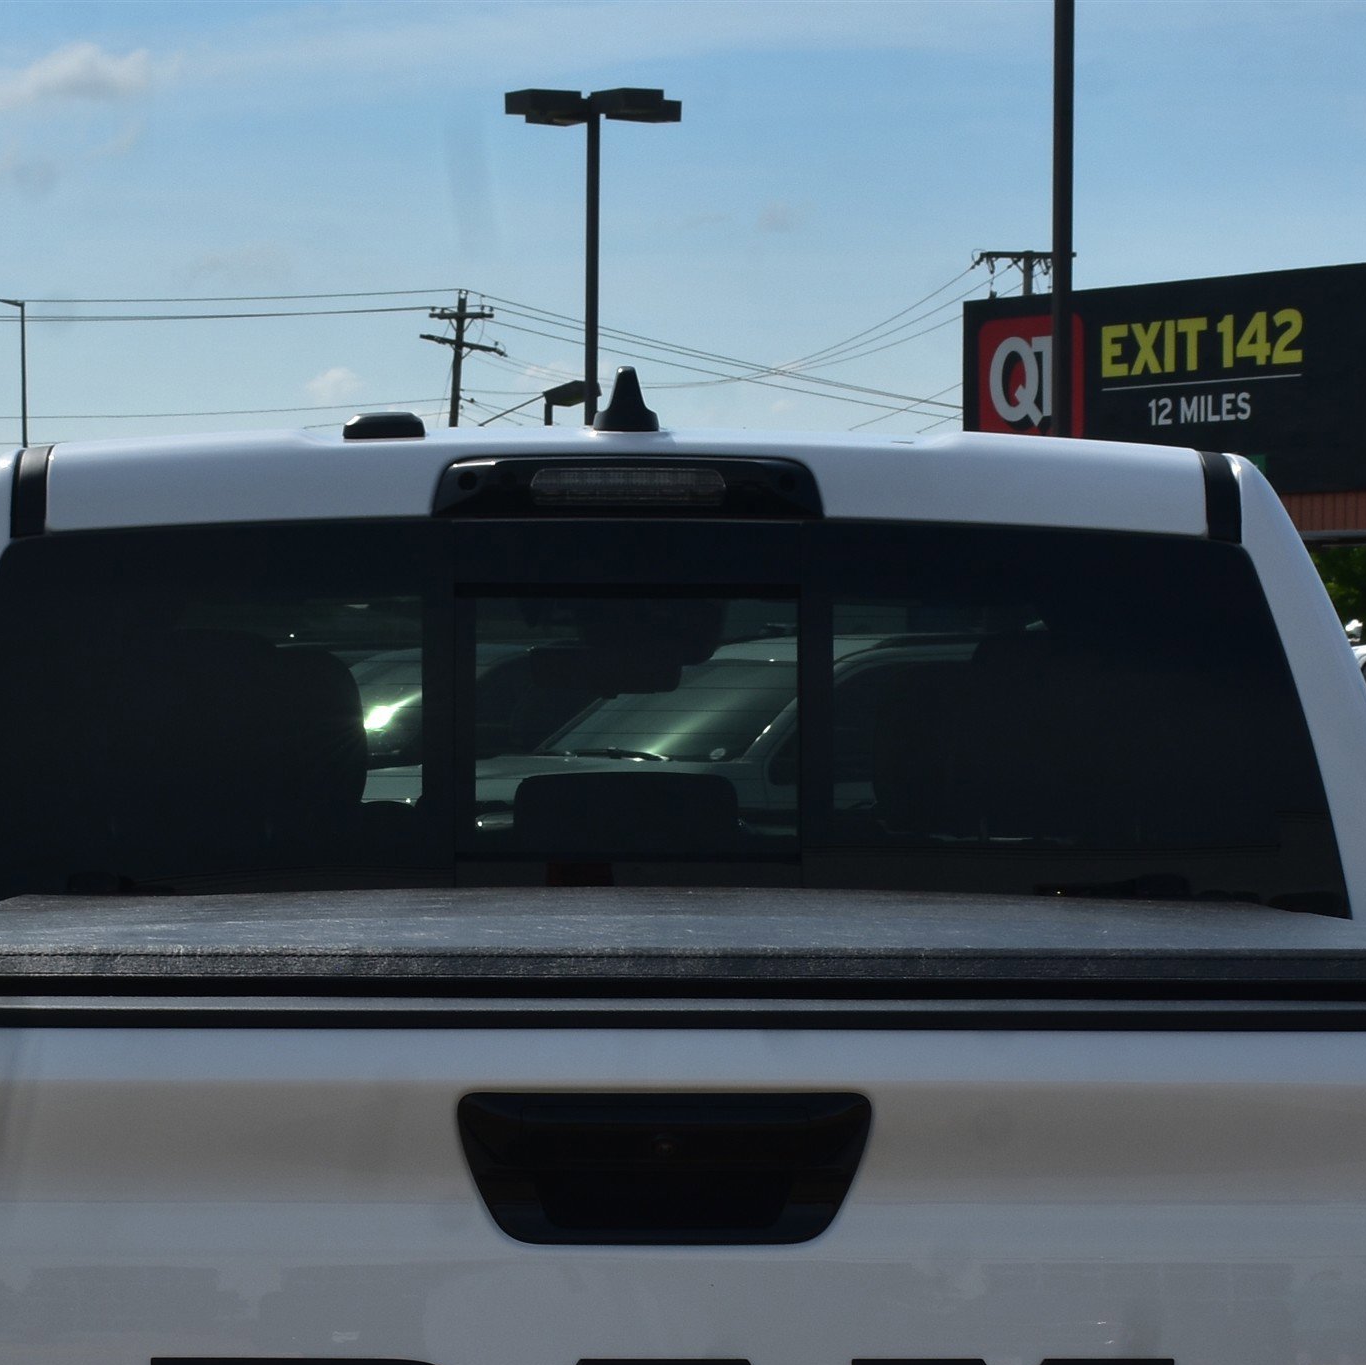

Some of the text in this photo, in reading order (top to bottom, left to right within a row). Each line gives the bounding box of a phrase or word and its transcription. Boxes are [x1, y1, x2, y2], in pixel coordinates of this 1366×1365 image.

[1100, 307, 1304, 379] EXIT 142
[1147, 391, 1252, 427] 12 MILES
